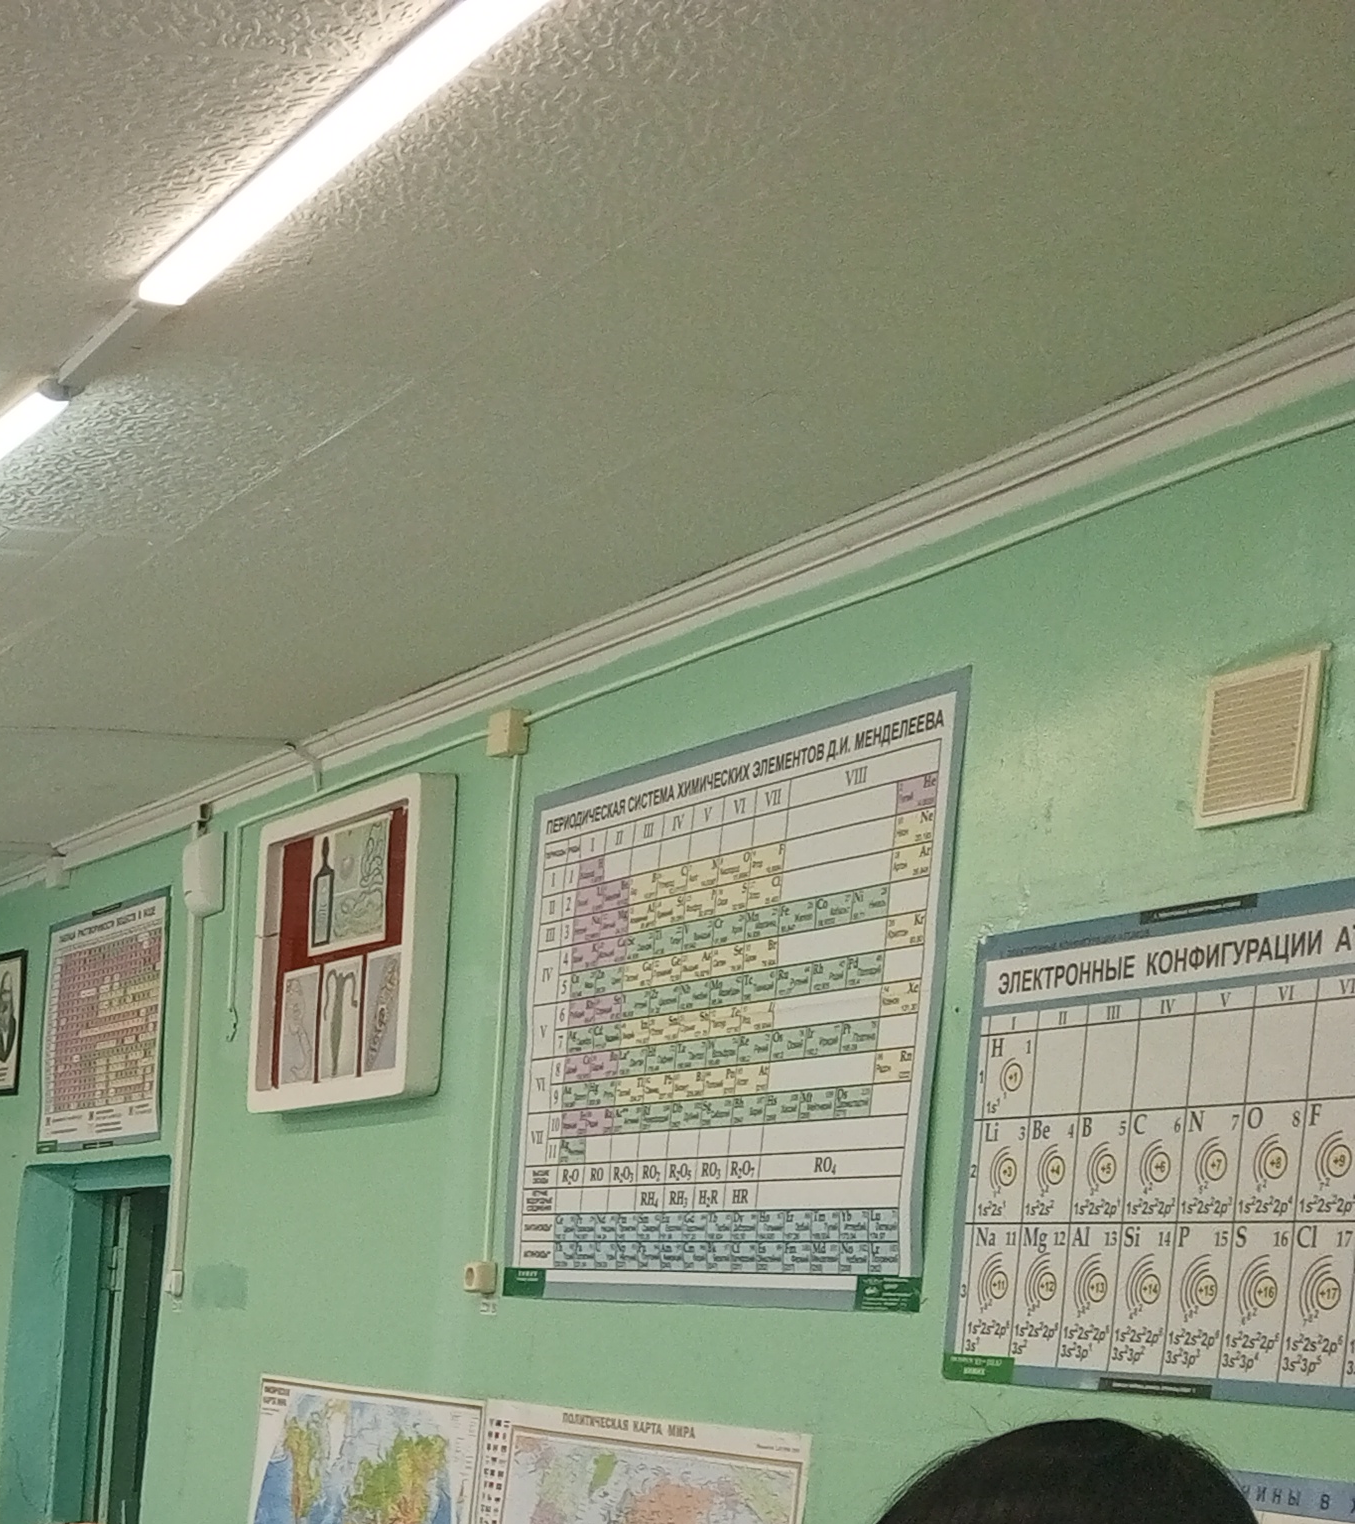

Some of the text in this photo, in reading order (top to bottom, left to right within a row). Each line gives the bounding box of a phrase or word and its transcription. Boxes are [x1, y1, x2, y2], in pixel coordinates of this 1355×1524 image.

[546, 709, 944, 835] ПЕРИОДИЧЕСКАЯ СИСТЕМА ХИМИЧЕСКИХ ЭЛЕМЕНТОВ Д.И. МЕНДЕЛЕЕВА
[923, 774, 936, 789] He
[615, 830, 624, 845] II
[643, 823, 654, 838] III
[671, 814, 685, 832] IV
[703, 807, 712, 822] V
[733, 797, 746, 813] VI
[765, 789, 781, 806] VII
[845, 766, 868, 786] VIII
[920, 810, 934, 823] Ne
[919, 846, 931, 858] Ar
[569, 870, 574, 884] 1
[853, 890, 864, 902] Ni
[565, 897, 571, 911] 2
[816, 898, 828, 910] Co
[914, 914, 925, 926] Kr
[564, 925, 570, 939] 3
[563, 953, 569, 965] 4
[998, 955, 1136, 995] ЭЛЕКТРОННЫЕ
[1146, 929, 1323, 976] КОНФИГУРАЦИИ
[561, 980, 567, 995] 5
[907, 982, 919, 994] Xe
[1058, 1011, 1068, 1025] II
[1107, 1005, 1121, 1020] III
[1160, 999, 1176, 1014] IV
[1220, 992, 1232, 1007] V
[1277, 985, 1295, 1002] VI
[559, 1008, 565, 1022] 6
[558, 1035, 564, 1049] 7
[991, 1038, 1032, 1057] H 1
[900, 1051, 912, 1062] Rn
[555, 1063, 560, 1077] 8
[979, 1070, 984, 1084] 1
[553, 1090, 559, 1104] 9
[551, 1118, 560, 1132] 10
[985, 1103, 1322, 1142] Li 3 Be 4 B 5 C 6 N 7 O 8 F
[548, 1145, 556, 1158] 11
[590, 1167, 604, 1181] RO
[970, 1165, 977, 1178] 2
[732, 1188, 748, 1204] HR
[976, 1225, 1354, 1253] Na 11 Mg 12 Al 13 Si 14 P 15 S 16 Cl 17
[960, 1284, 967, 1298] 3
[562, 1411, 696, 1439] ПОЛИТИЧЕСКАЯ КАРТА МИРА
